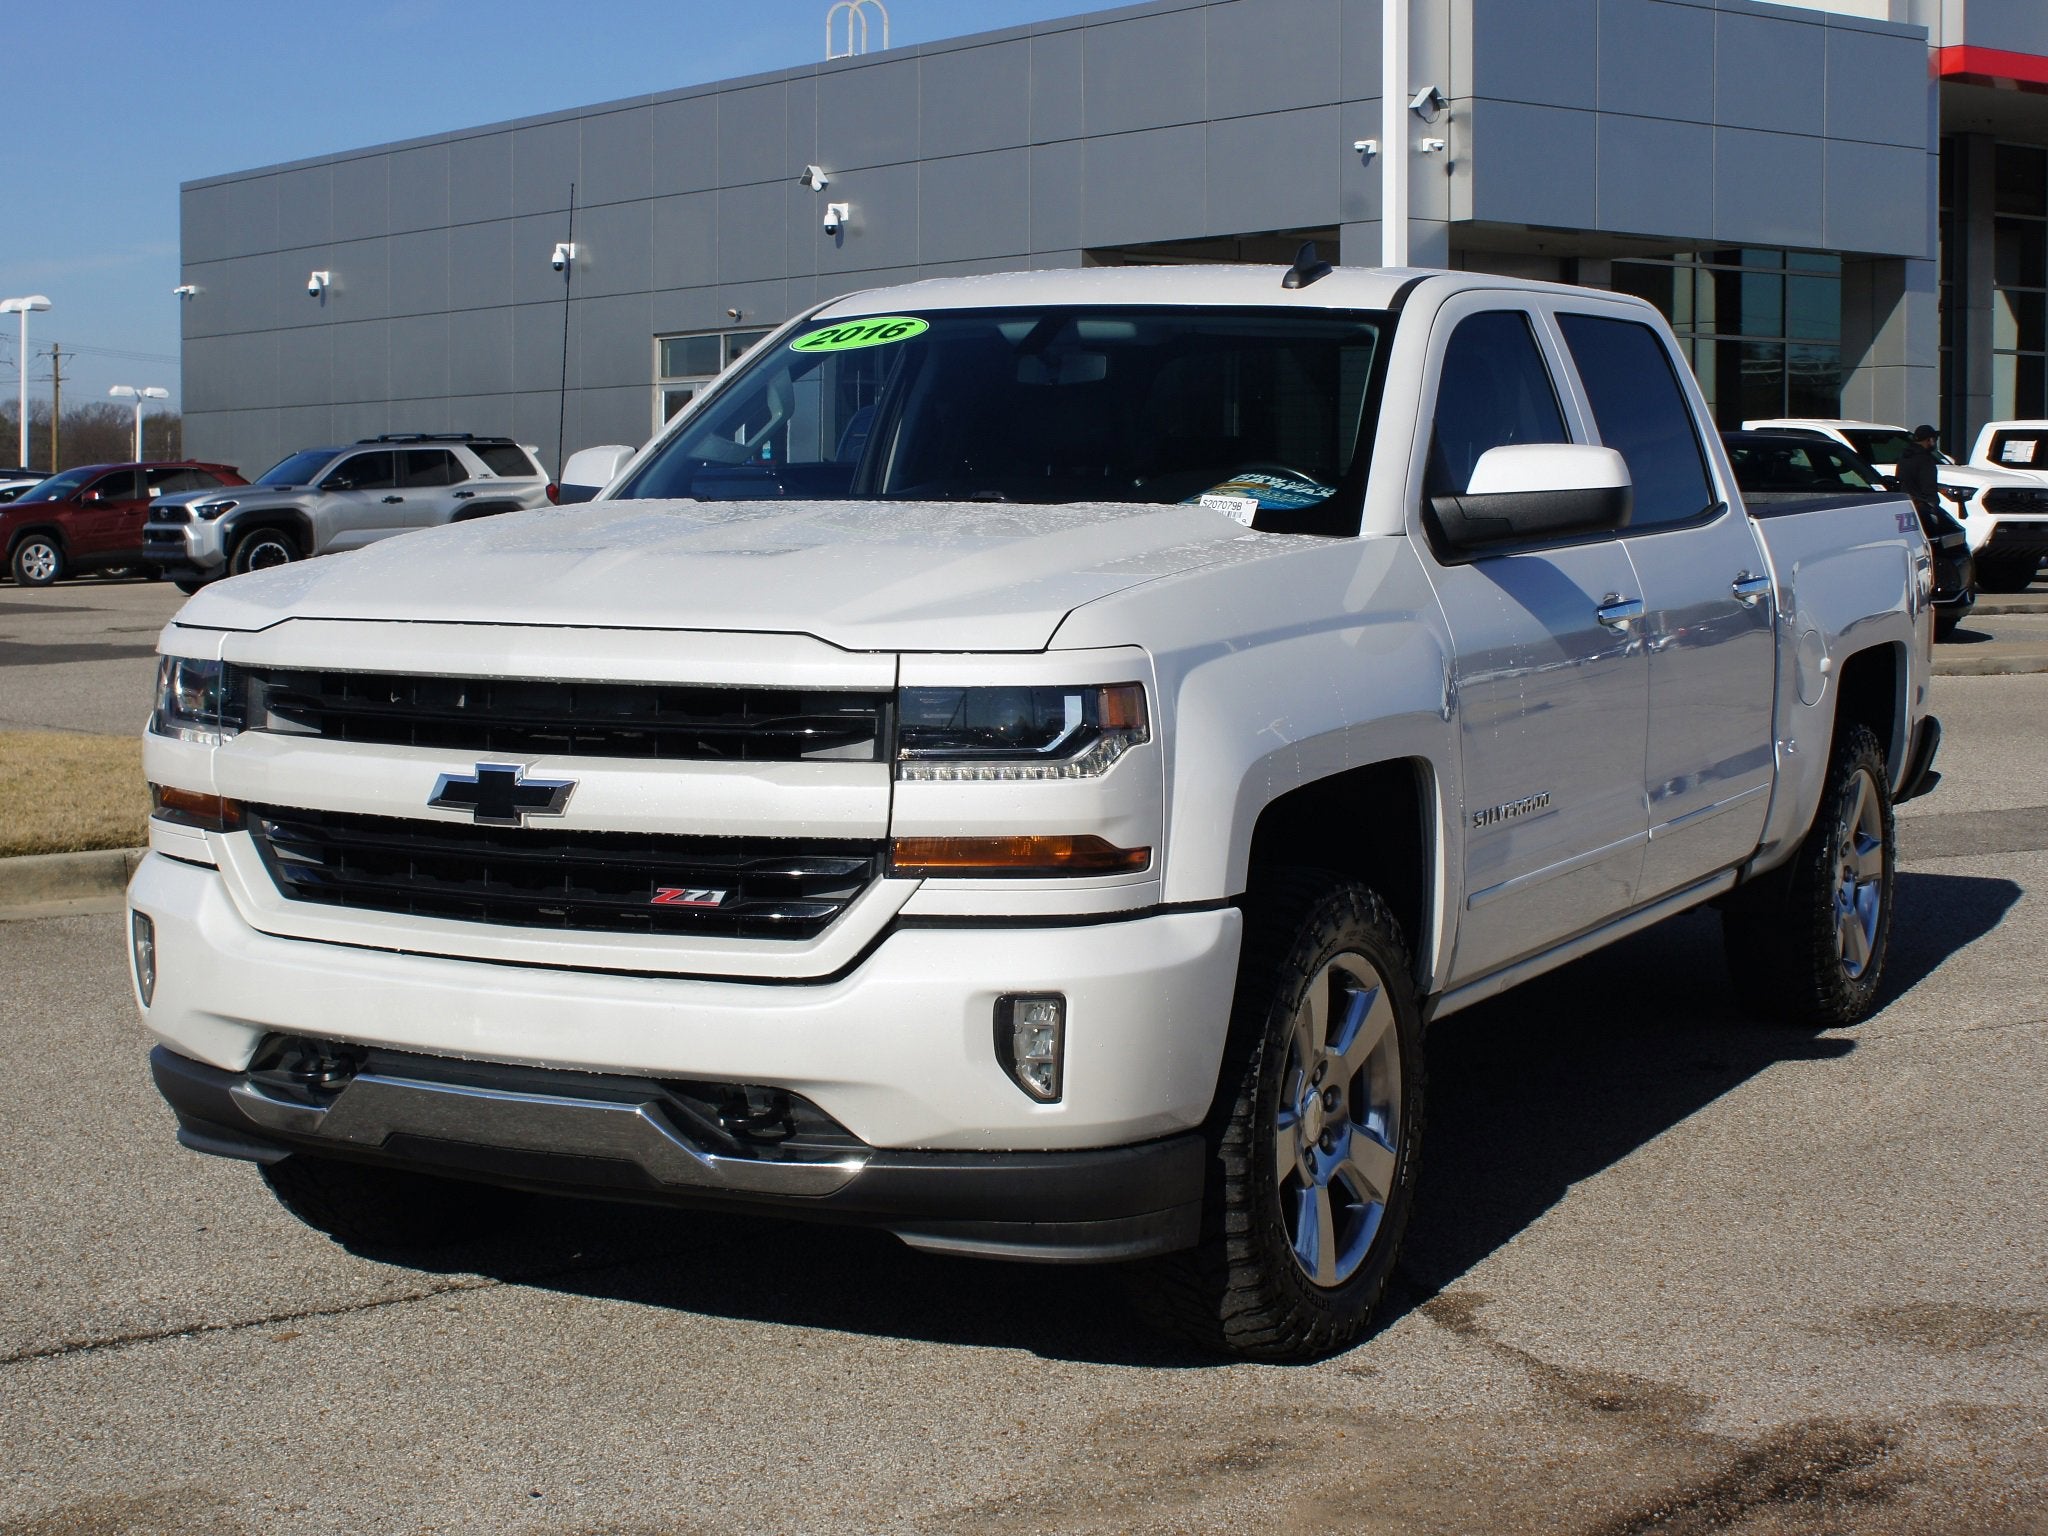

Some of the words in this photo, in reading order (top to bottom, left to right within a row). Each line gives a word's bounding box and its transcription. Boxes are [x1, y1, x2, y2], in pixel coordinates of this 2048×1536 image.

[801, 321, 916, 348] 2016
[1473, 790, 1551, 829] SILVERADO
[651, 887, 726, 907] Z71
